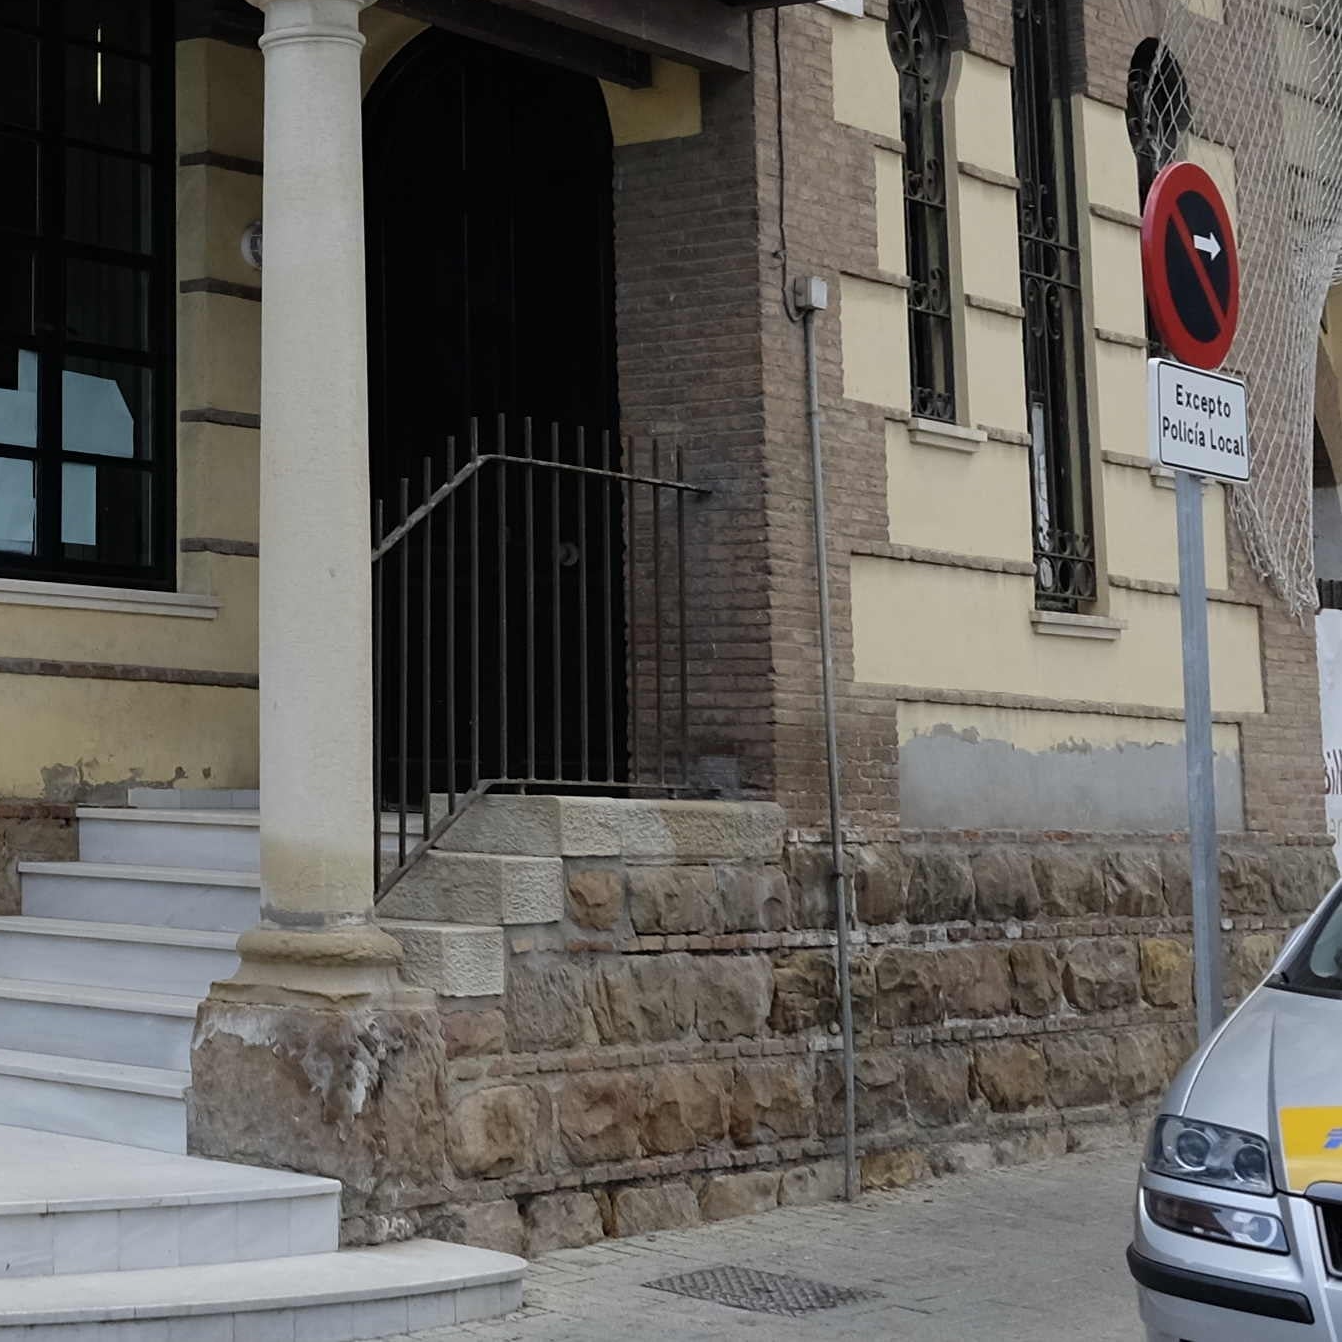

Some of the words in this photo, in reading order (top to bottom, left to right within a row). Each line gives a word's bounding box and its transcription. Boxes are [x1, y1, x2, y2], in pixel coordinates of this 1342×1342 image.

[1175, 383, 1232, 419] Excepto
[1162, 415, 1206, 448] Policía
[1210, 428, 1245, 457] Local
